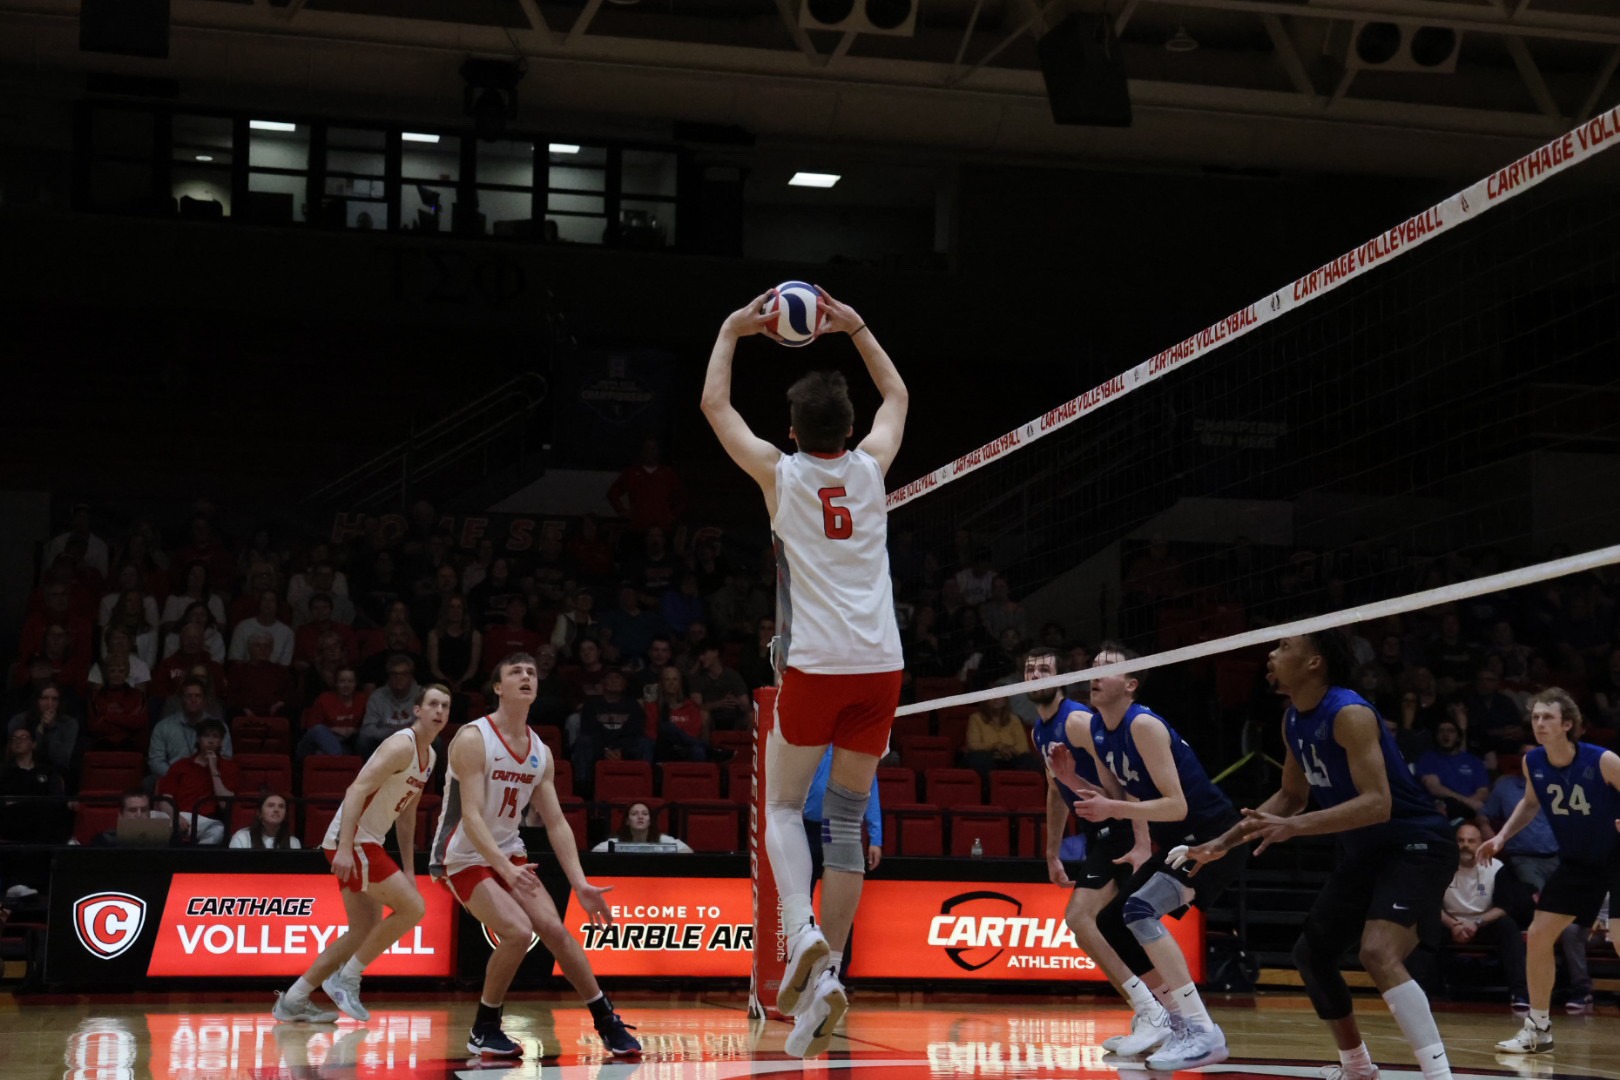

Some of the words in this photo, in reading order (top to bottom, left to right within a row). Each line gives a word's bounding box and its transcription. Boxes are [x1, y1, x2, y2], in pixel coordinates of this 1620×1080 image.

[1486, 133, 1575, 200] CARTHAGE
[1293, 254, 1356, 301] CARTHAGE
[1357, 206, 1443, 267] VOLLEYBALL
[1149, 336, 1195, 375] CARTHAGE
[1195, 304, 1258, 348] VOLLEYBALL
[1040, 402, 1077, 431] CARTHAGE
[1077, 375, 1124, 412] VOLLEYBALL
[952, 452, 981, 475] CARTHAGE
[981, 430, 1021, 461] VOLLEYBALL
[331, 512, 488, 549] HOE
[818, 487, 853, 540] 6
[492, 770, 536, 784] CARTHAGE
[1105, 751, 1140, 786] 14
[1297, 738, 1333, 788] 15
[1546, 783, 1592, 816] 24
[92, 904, 128, 945] C
[186, 896, 316, 917] CARTHAGE
[597, 905, 687, 919] ELCOME
[696, 905, 721, 919] TO
[177, 924, 435, 955] VOLLEYLL
[580, 922, 706, 951] TARBLE
[706, 923, 754, 951] AR
[927, 915, 1081, 949] CARTHA
[1007, 954, 1096, 969] ATHLETICS
